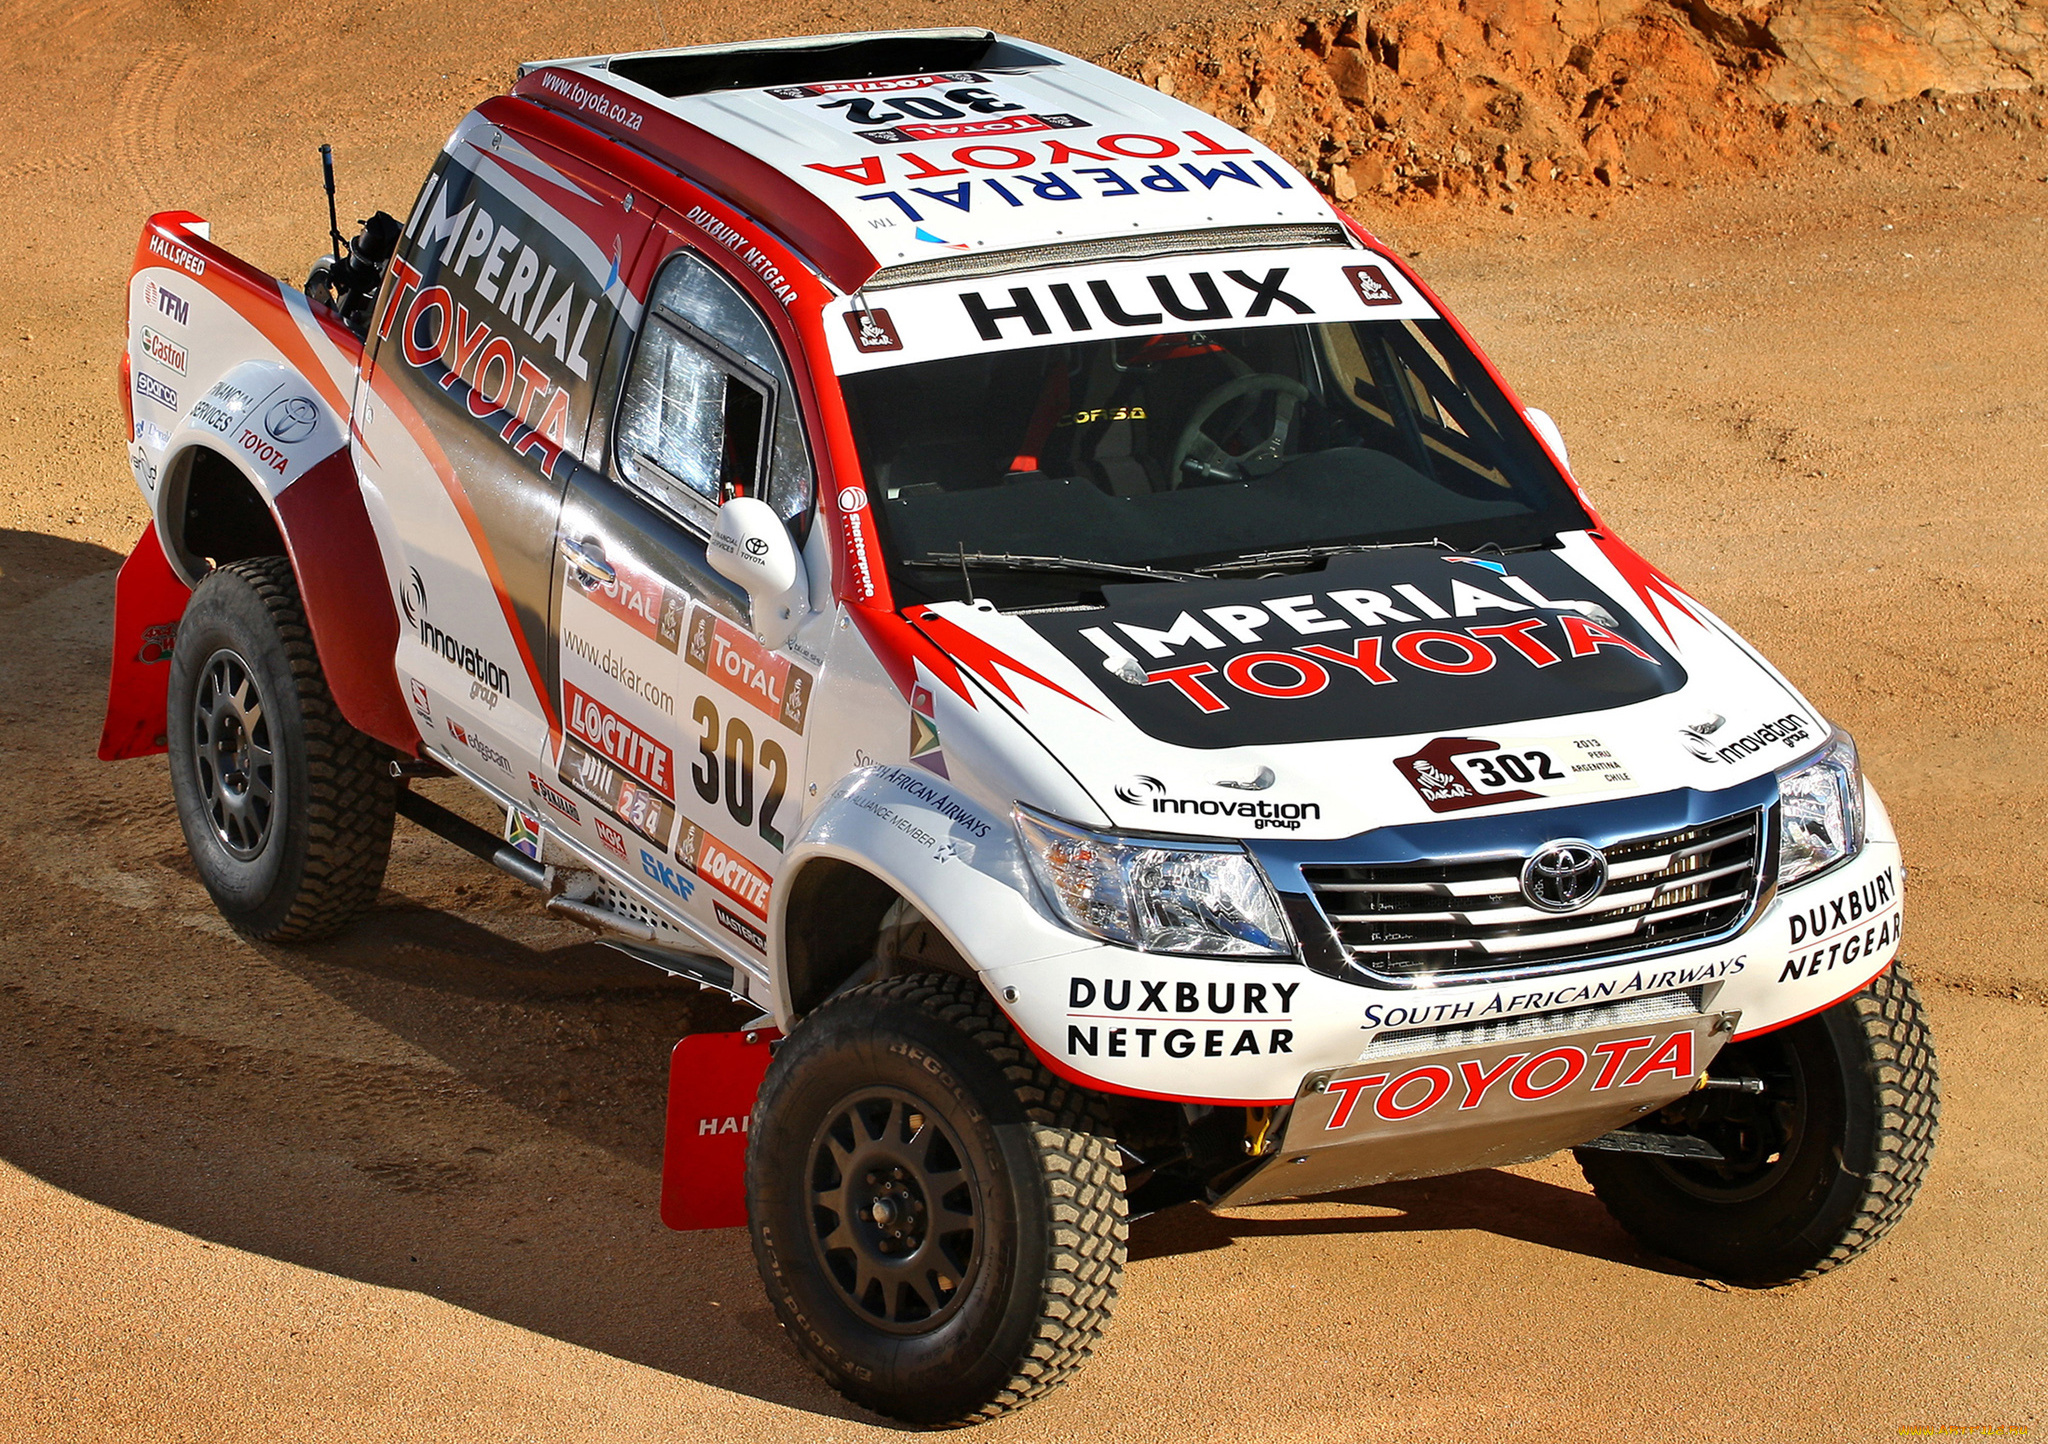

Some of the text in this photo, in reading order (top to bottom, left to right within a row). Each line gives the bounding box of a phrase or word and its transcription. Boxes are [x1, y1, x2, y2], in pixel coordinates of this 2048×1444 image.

[541, 72, 643, 131] www.toyota.co.za
[816, 88, 1027, 124] 302
[823, 75, 934, 92] LOCTITE
[905, 117, 1043, 135] TOTAL
[802, 130, 1254, 185] TOYOTA
[855, 160, 1294, 222] IMPERIAL
[149, 234, 206, 276] HALLSPEED
[405, 172, 598, 381] IMPERIAL
[685, 205, 799, 307] DUXBURY NETGEAR
[157, 286, 190, 326] TFM
[959, 267, 1316, 340] HILUX
[150, 334, 186, 372] Castrol
[859, 334, 893, 347] DAKAR
[138, 374, 177, 406] sparco
[376, 254, 571, 480] TOYOTA
[190, 400, 234, 432] SERVICES
[237, 429, 290, 475] TOYOTA
[740, 552, 766, 566] TOYOTA
[849, 513, 874, 598] Shatterprufe
[603, 575, 657, 625] OTAL
[1078, 575, 1570, 658] IMPERIAL
[420, 619, 510, 698] innovation
[564, 627, 674, 716] www.dakar.com
[714, 634, 781, 704] TOTAL
[1140, 614, 1661, 715] TOYOTA
[469, 681, 498, 710] group
[467, 733, 513, 773] edgecam
[571, 693, 668, 787] LOCTITE
[1573, 738, 1602, 749] 2013
[1587, 750, 1612, 759] PERU
[1715, 713, 1809, 764] innovation
[1782, 729, 1810, 748] group
[692, 695, 788, 854] 302
[1466, 751, 1566, 787] 302
[1571, 761, 1622, 773] ARGENTINA
[1603, 772, 1632, 782] CHILE
[886, 768, 938, 803] AFRICAN
[931, 795, 992, 838] AIRWAYS
[1152, 797, 1320, 820] innovation
[1419, 783, 1473, 802] DAKAR
[598, 822, 624, 853] NGK
[851, 794, 893, 820] ALLIANCE
[889, 814, 936, 848] MEMBER
[1254, 818, 1302, 831] group
[640, 848, 696, 902] SKF
[701, 846, 770, 907] LOCTITE
[1788, 866, 1896, 945] DUXBURY
[1777, 912, 1901, 983] NETGEAR
[1068, 977, 1301, 1014] DUXBURY
[1360, 954, 1748, 1031] SOUTH AFRICAN AIRWAYS
[1067, 1025, 1294, 1058] NETGEAR
[1323, 1028, 1696, 1130] TOYOTA
